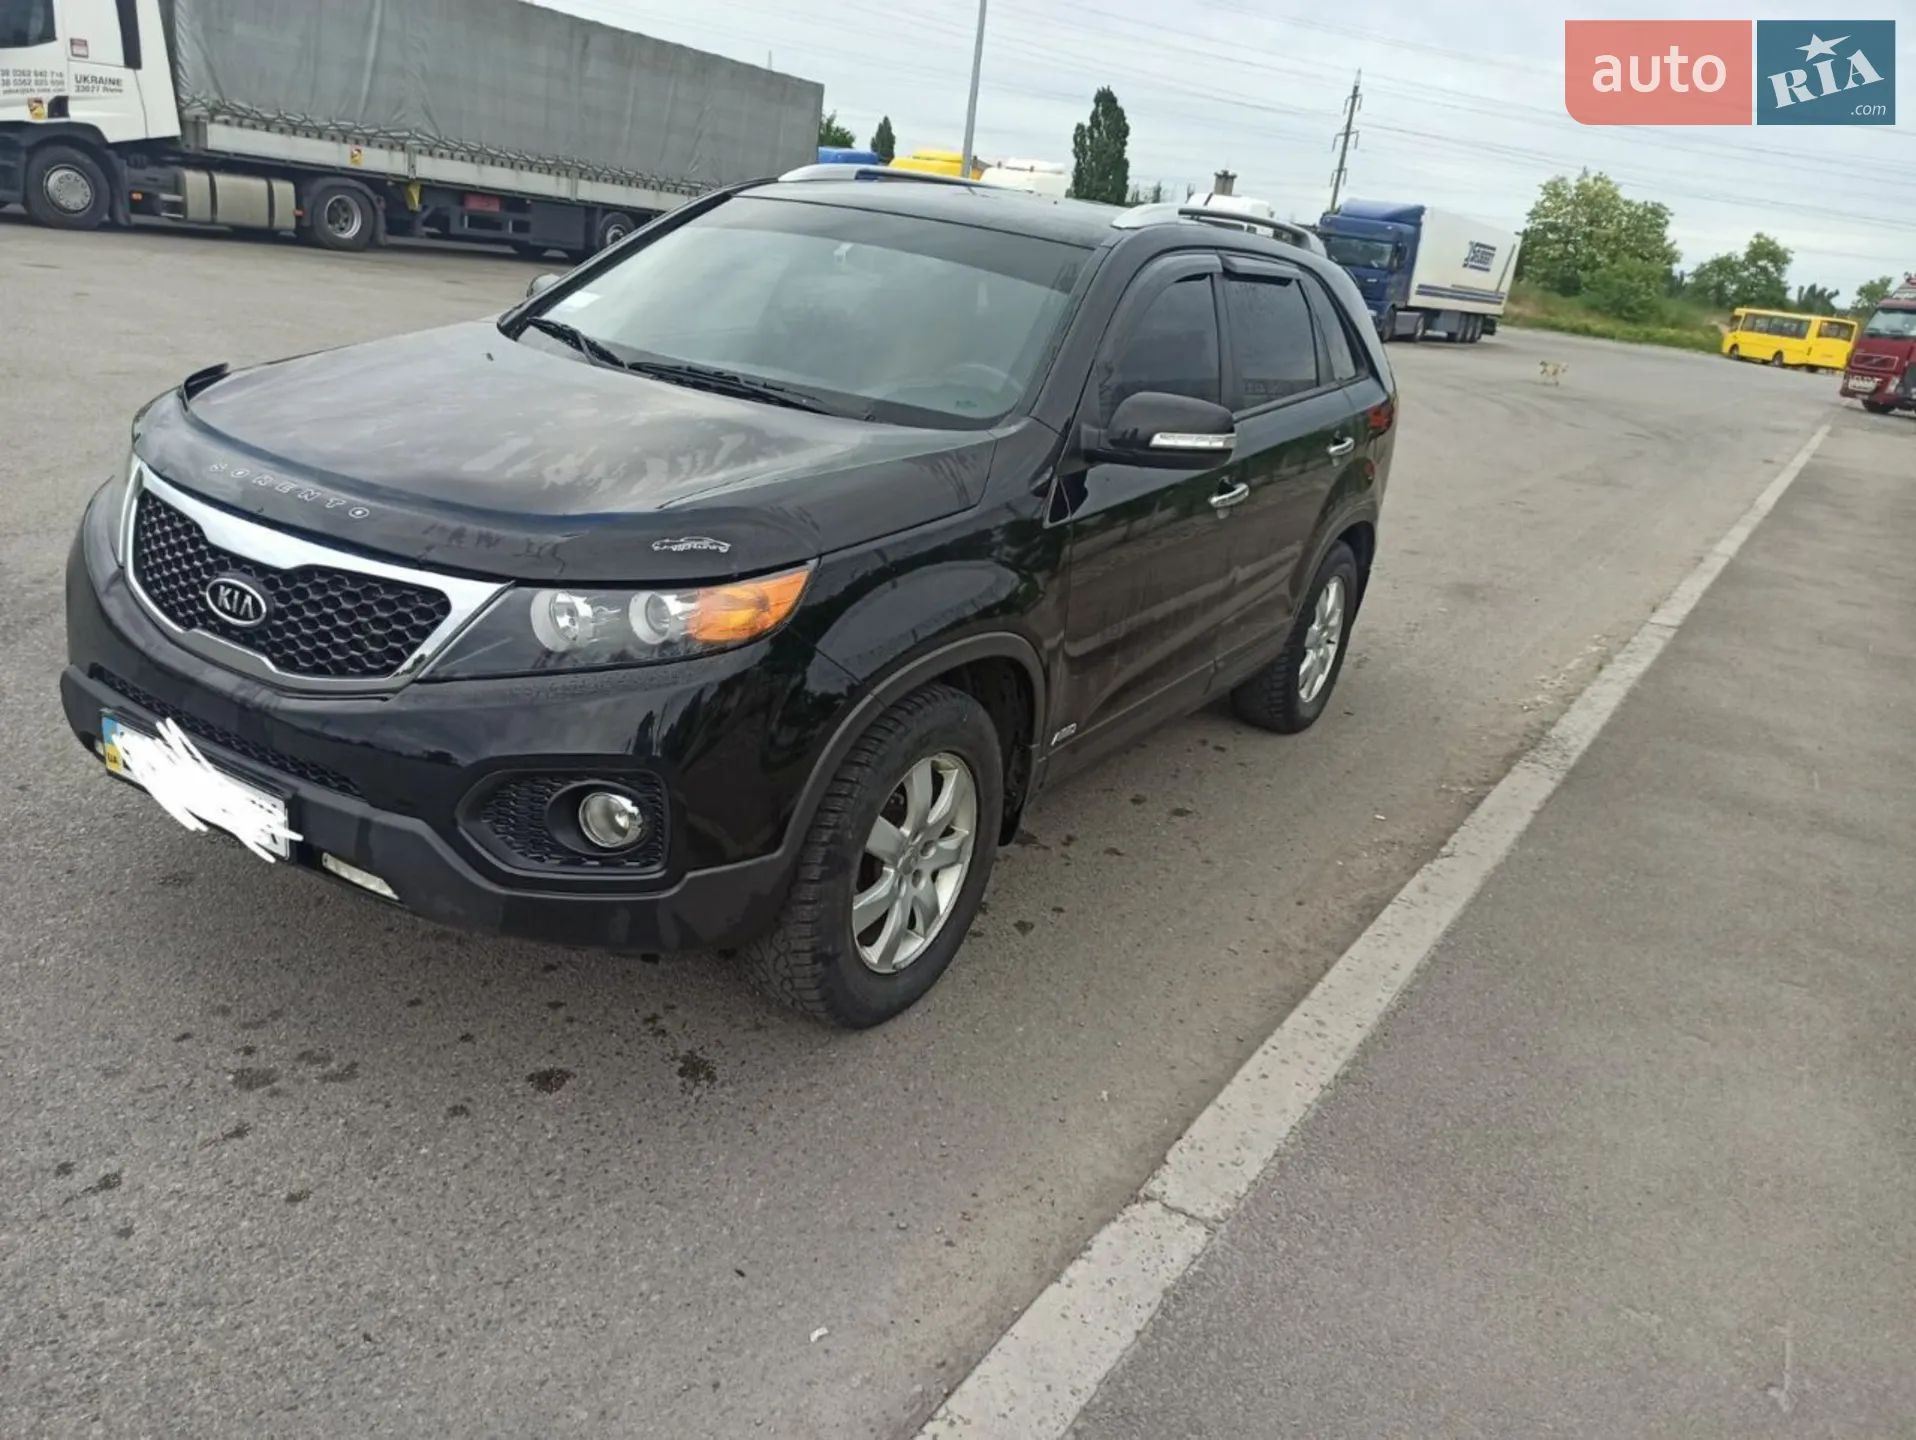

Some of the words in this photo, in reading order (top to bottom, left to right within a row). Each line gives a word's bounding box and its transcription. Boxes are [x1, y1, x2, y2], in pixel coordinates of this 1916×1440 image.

[74, 74, 122, 87] UKRAINE
[210, 463, 369, 518] SORENTO
[218, 585, 254, 619] KIA
